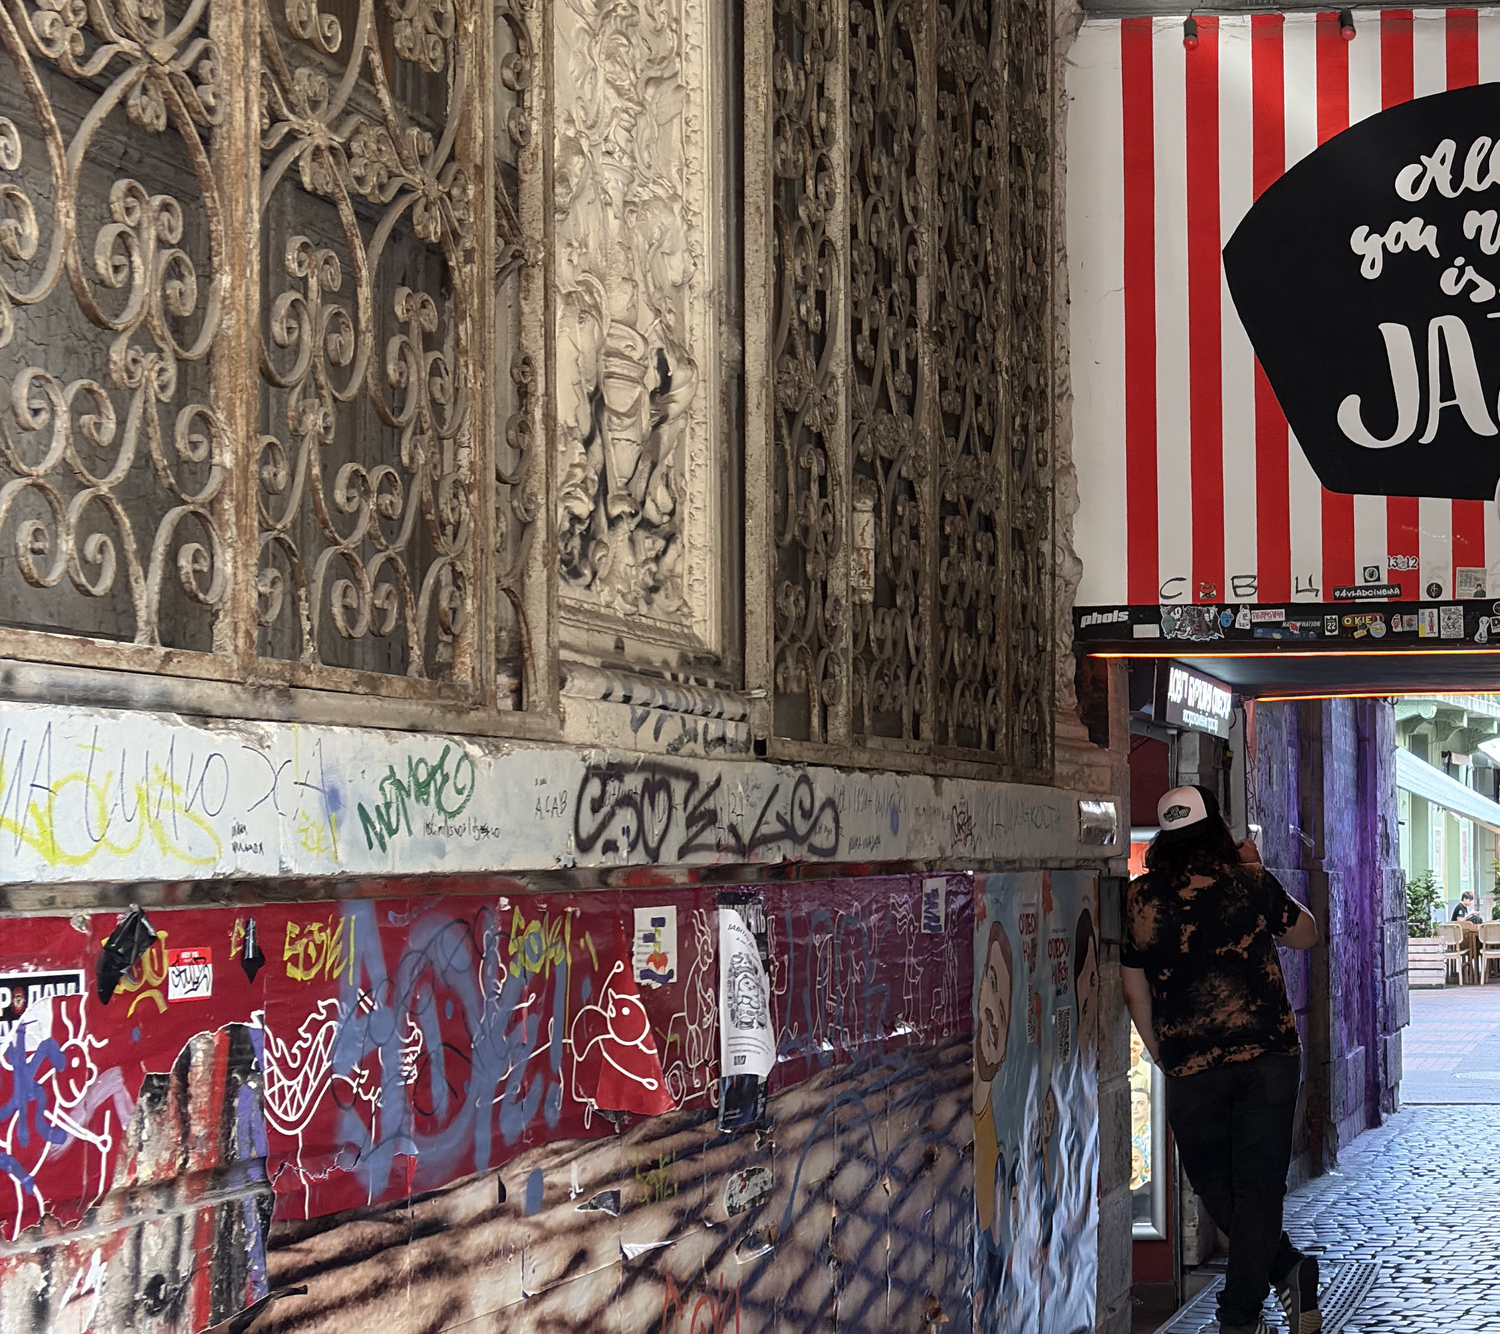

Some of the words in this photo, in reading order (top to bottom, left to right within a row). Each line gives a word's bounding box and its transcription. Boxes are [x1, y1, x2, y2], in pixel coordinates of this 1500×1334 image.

[1350, 221, 1440, 280] you
[1080, 609, 1130, 629] phols
[1327, 622, 1336, 630] 22
